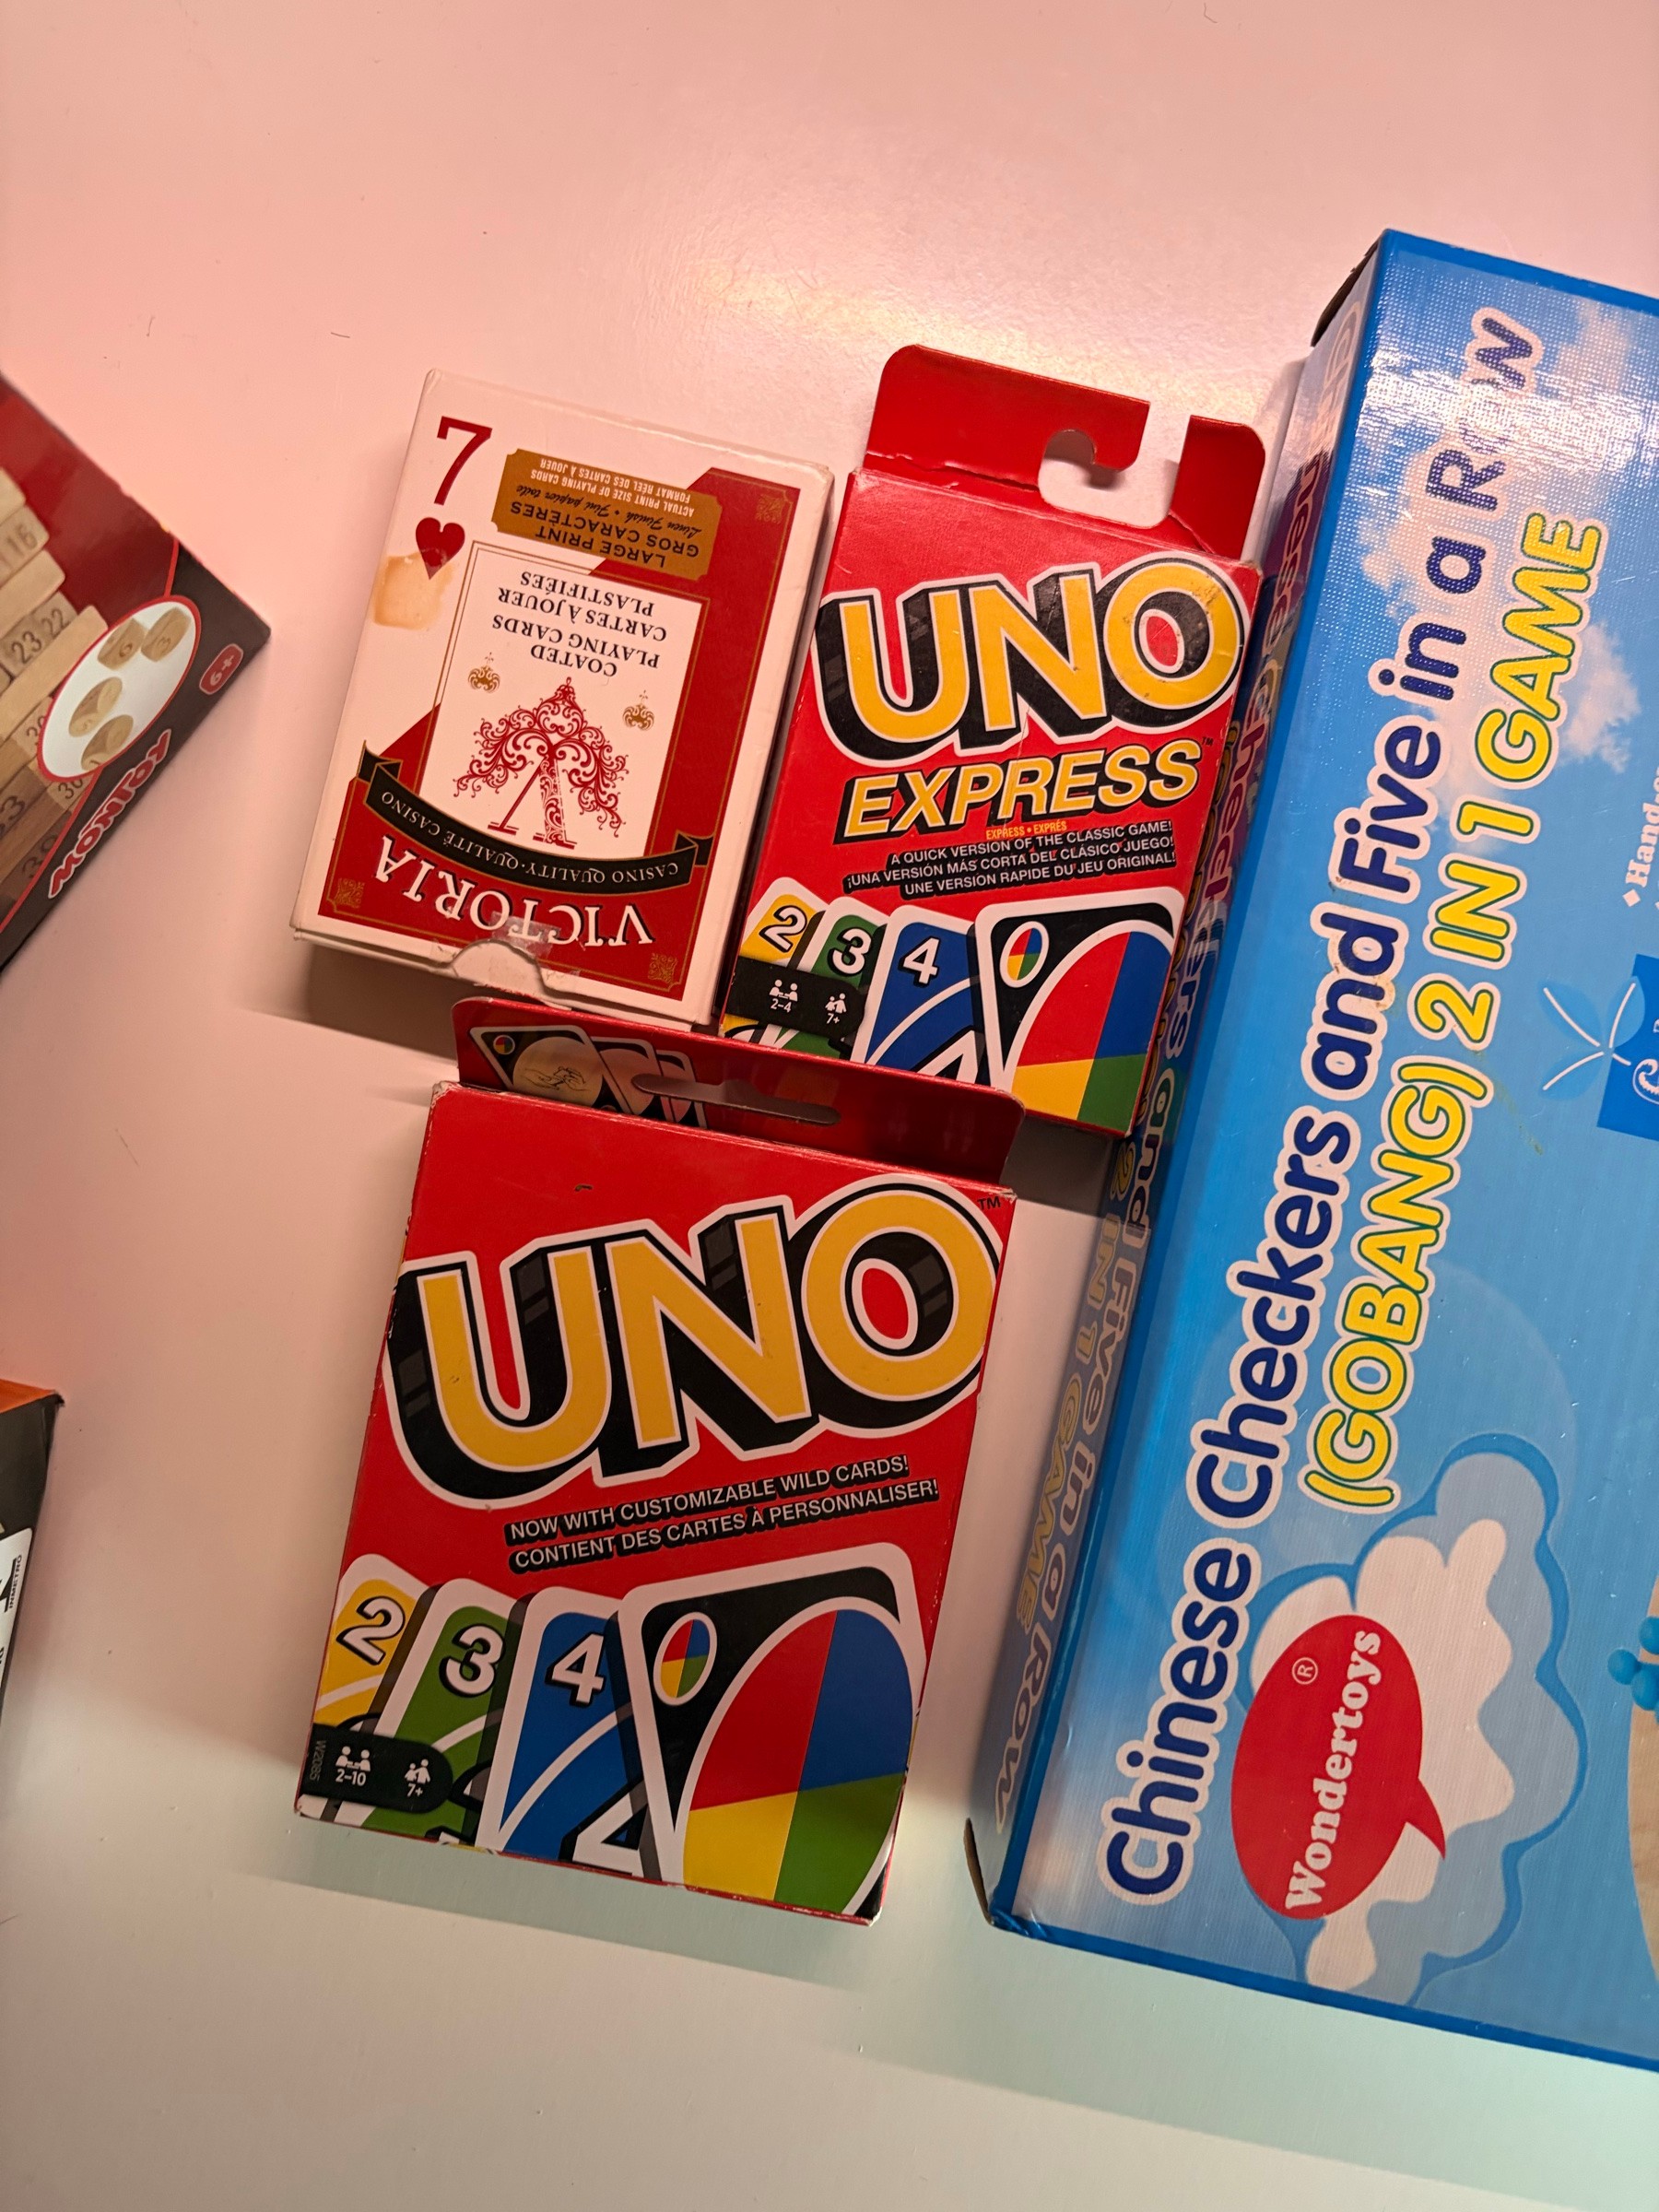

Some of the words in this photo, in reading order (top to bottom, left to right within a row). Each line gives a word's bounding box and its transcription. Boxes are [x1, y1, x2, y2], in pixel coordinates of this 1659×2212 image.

[434, 415, 492, 506] 7
[530, 469, 559, 485] CARDS
[540, 458, 569, 474] JOUER
[578, 467, 611, 485] CARTES
[613, 476, 630, 488] DES
[516, 485, 541, 499] toile
[544, 491, 583, 508] papier
[561, 477, 597, 495] PLAYING
[598, 487, 610, 498] OF
[613, 488, 632, 502] SIZE
[633, 480, 654, 496] RÉEL
[634, 495, 660, 509] PRINT
[655, 487, 691, 503] FORMAT
[511, 500, 640, 542] CARACTÈRES
[583, 501, 610, 517] Fini
[624, 512, 664, 530] Finish
[664, 501, 695, 517] ACTUAL
[667, 521, 702, 539] Linen
[535, 525, 594, 550] PRINT
[600, 540, 665, 568] LARGE
[646, 535, 699, 558] GROS
[1425, 535, 1487, 595] a
[498, 586, 566, 617] JOUER
[521, 571, 655, 618] PLASTIFIÉES
[568, 604, 582, 624] À
[11, 630, 42, 665] 23
[492, 614, 563, 643] CARDS
[585, 609, 667, 641] CARTES
[1475, 511, 1603, 783] GAME
[209, 653, 235, 687] 6+
[531, 643, 618, 677] COATED
[569, 633, 660, 669] PLAYING
[817, 553, 1252, 764] UNO
[1378, 620, 1467, 701] in
[837, 737, 1203, 841] EXPRESS
[1338, 724, 1441, 894] Five
[48, 729, 172, 900] MONTOY
[382, 791, 441, 836] CASINO
[985, 825, 1025, 841] EXPRESS
[1033, 819, 1067, 835] EXPRÉS
[1456, 799, 1535, 838] 1
[847, 874, 881, 889] ¡UNA
[883, 863, 943, 882] VERSIÓN
[947, 859, 977, 876] MÁS
[980, 853, 1026, 870] CORTA
[1030, 851, 1057, 865] DEL
[1060, 841, 1120, 860] CLÁSICO
[1124, 836, 1174, 853] JUEGO!
[890, 853, 900, 865] A
[903, 847, 947, 865] QUICK
[950, 840, 1011, 858] VERSION
[1014, 837, 1033, 850] OF
[1036, 832, 1064, 847] THE
[1066, 826, 1124, 843] CLASSIC
[1128, 820, 1172, 835] GAME!
[375, 834, 654, 947] VICTORIA
[611, 862, 679, 884] CASINO
[904, 881, 934, 896] UNE
[936, 874, 996, 891] VERSION
[1000, 866, 1051, 884] RAPIDE
[1053, 863, 1074, 877] DU
[1077, 860, 1104, 875] JEU
[1107, 852, 1176, 870] ORIGINAL!
[760, 905, 807, 952] 2
[1430, 859, 1521, 963] IN
[829, 927, 873, 976] 3
[899, 935, 940, 986] 4
[825, 1012, 840, 1025] 7+
[1311, 911, 1400, 1091] and
[1413, 978, 1495, 1044] 2
[1111, 1141, 1136, 1201] 2
[1123, 1067, 1175, 1249] and
[1087, 1212, 1122, 1311] IN
[1303, 1062, 1489, 1508] (GOBANG)
[1196, 1112, 1352, 1521] Checkers
[384, 1178, 1003, 1506] UNO
[1075, 1320, 1098, 1365] 1
[1082, 1256, 1137, 1435] Five
[511, 1516, 559, 1540] NOW
[563, 1507, 616, 1531] WITH
[620, 1477, 776, 1521] CUSTOMIZABLE
[780, 1469, 830, 1492] WILD
[835, 1454, 909, 1482] CARDS!
[1016, 1371, 1083, 1636] GAME
[1059, 1440, 1096, 1536] in
[515, 1535, 616, 1568] CONTIENT
[621, 1528, 662, 1550] DES
[666, 1512, 746, 1542] CARTES
[751, 1506, 765, 1527] À
[769, 1478, 939, 1524] PERSONNALISER!
[8, 1554, 23, 1609] INMETRO
[1041, 1542, 1065, 1622] a
[335, 1595, 406, 1665] 2
[439, 1623, 506, 1698] 3
[545, 1631, 606, 1707] 4
[994, 1622, 1053, 1834] Row
[1103, 1546, 1253, 1898] Chinese
[335, 1768, 367, 1787] 2-10
[406, 1782, 423, 1797] 7+
[1284, 1629, 1381, 1913] Wondertoys
